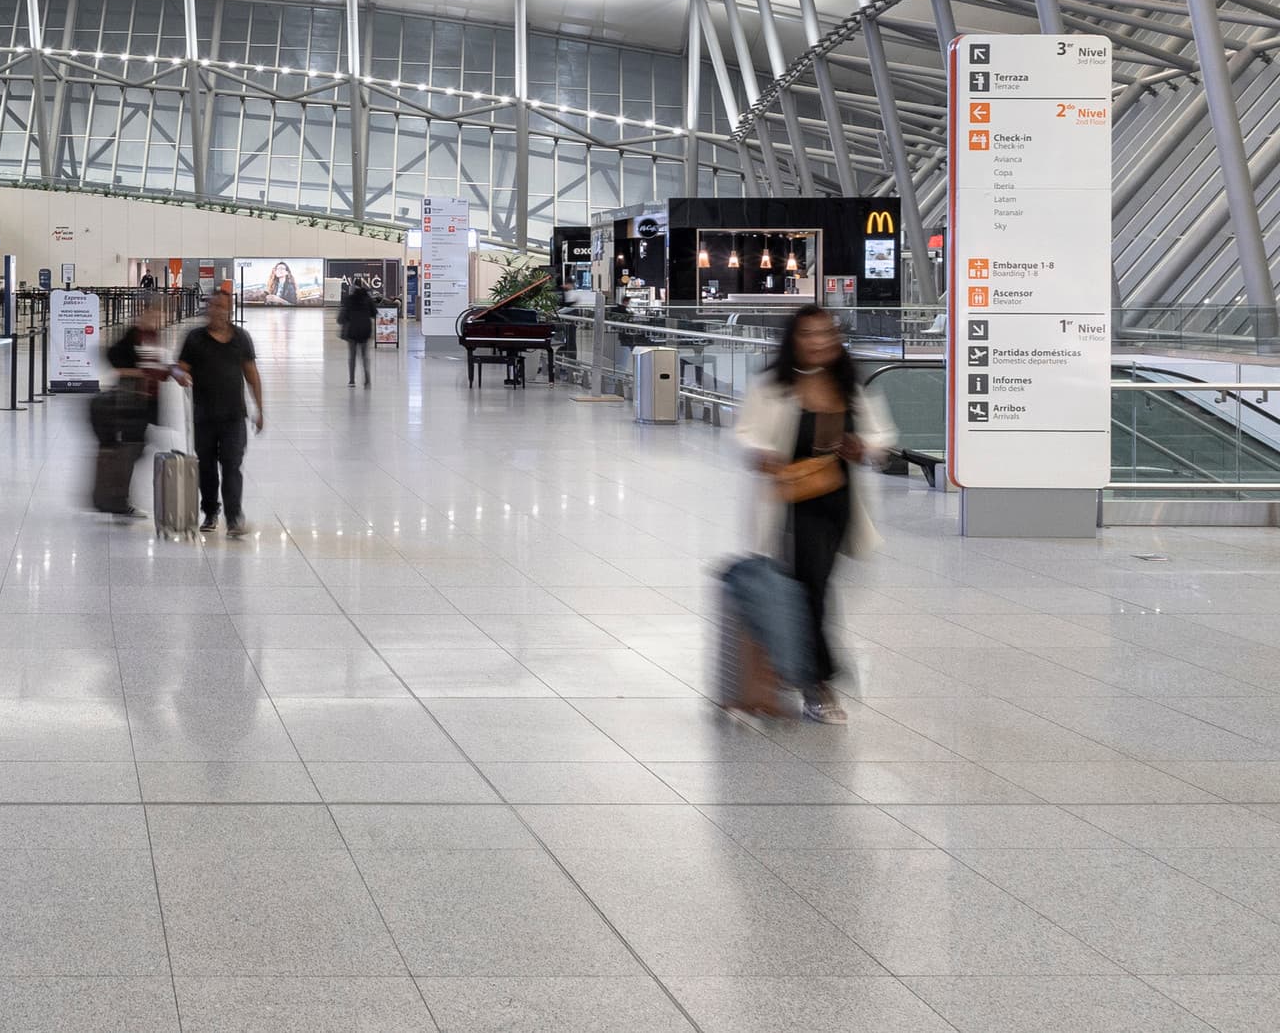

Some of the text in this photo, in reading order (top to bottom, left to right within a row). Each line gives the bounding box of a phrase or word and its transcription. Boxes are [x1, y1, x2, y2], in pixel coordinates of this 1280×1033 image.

[1078, 47, 1107, 57] Nivel
[1077, 57, 1106, 65] 3rd Floor
[994, 73, 1029, 82] Terraza
[994, 82, 1020, 90] Terrace
[1078, 108, 1107, 118] Nivel
[1089, 118, 1106, 126] Floor
[993, 133, 1032, 142] Check-in
[993, 142, 1025, 150] Check-in
[993, 155, 1023, 164] Avianca
[993, 168, 1013, 177] Copa
[993, 182, 1015, 190] Iberia
[993, 195, 1017, 204] Latam
[993, 208, 1024, 217] Paranair
[993, 222, 1007, 231] Sky
[992, 261, 1055, 270] Embarque 1-8
[992, 269, 1039, 278] Boarding 1-8
[992, 288, 1033, 297] Ascensor
[992, 297, 1023, 305] Elevator
[1078, 323, 1106, 334] Nivel
[1078, 334, 1106, 342] 1st Floor
[992, 347, 1082, 357] Partidas domésticas
[992, 357, 1067, 366] Domestic departures
[992, 375, 1032, 385] Informes
[992, 384, 1025, 392] Info desk
[992, 403, 1026, 413] Arribos
[992, 412, 1020, 420] Arrivals
